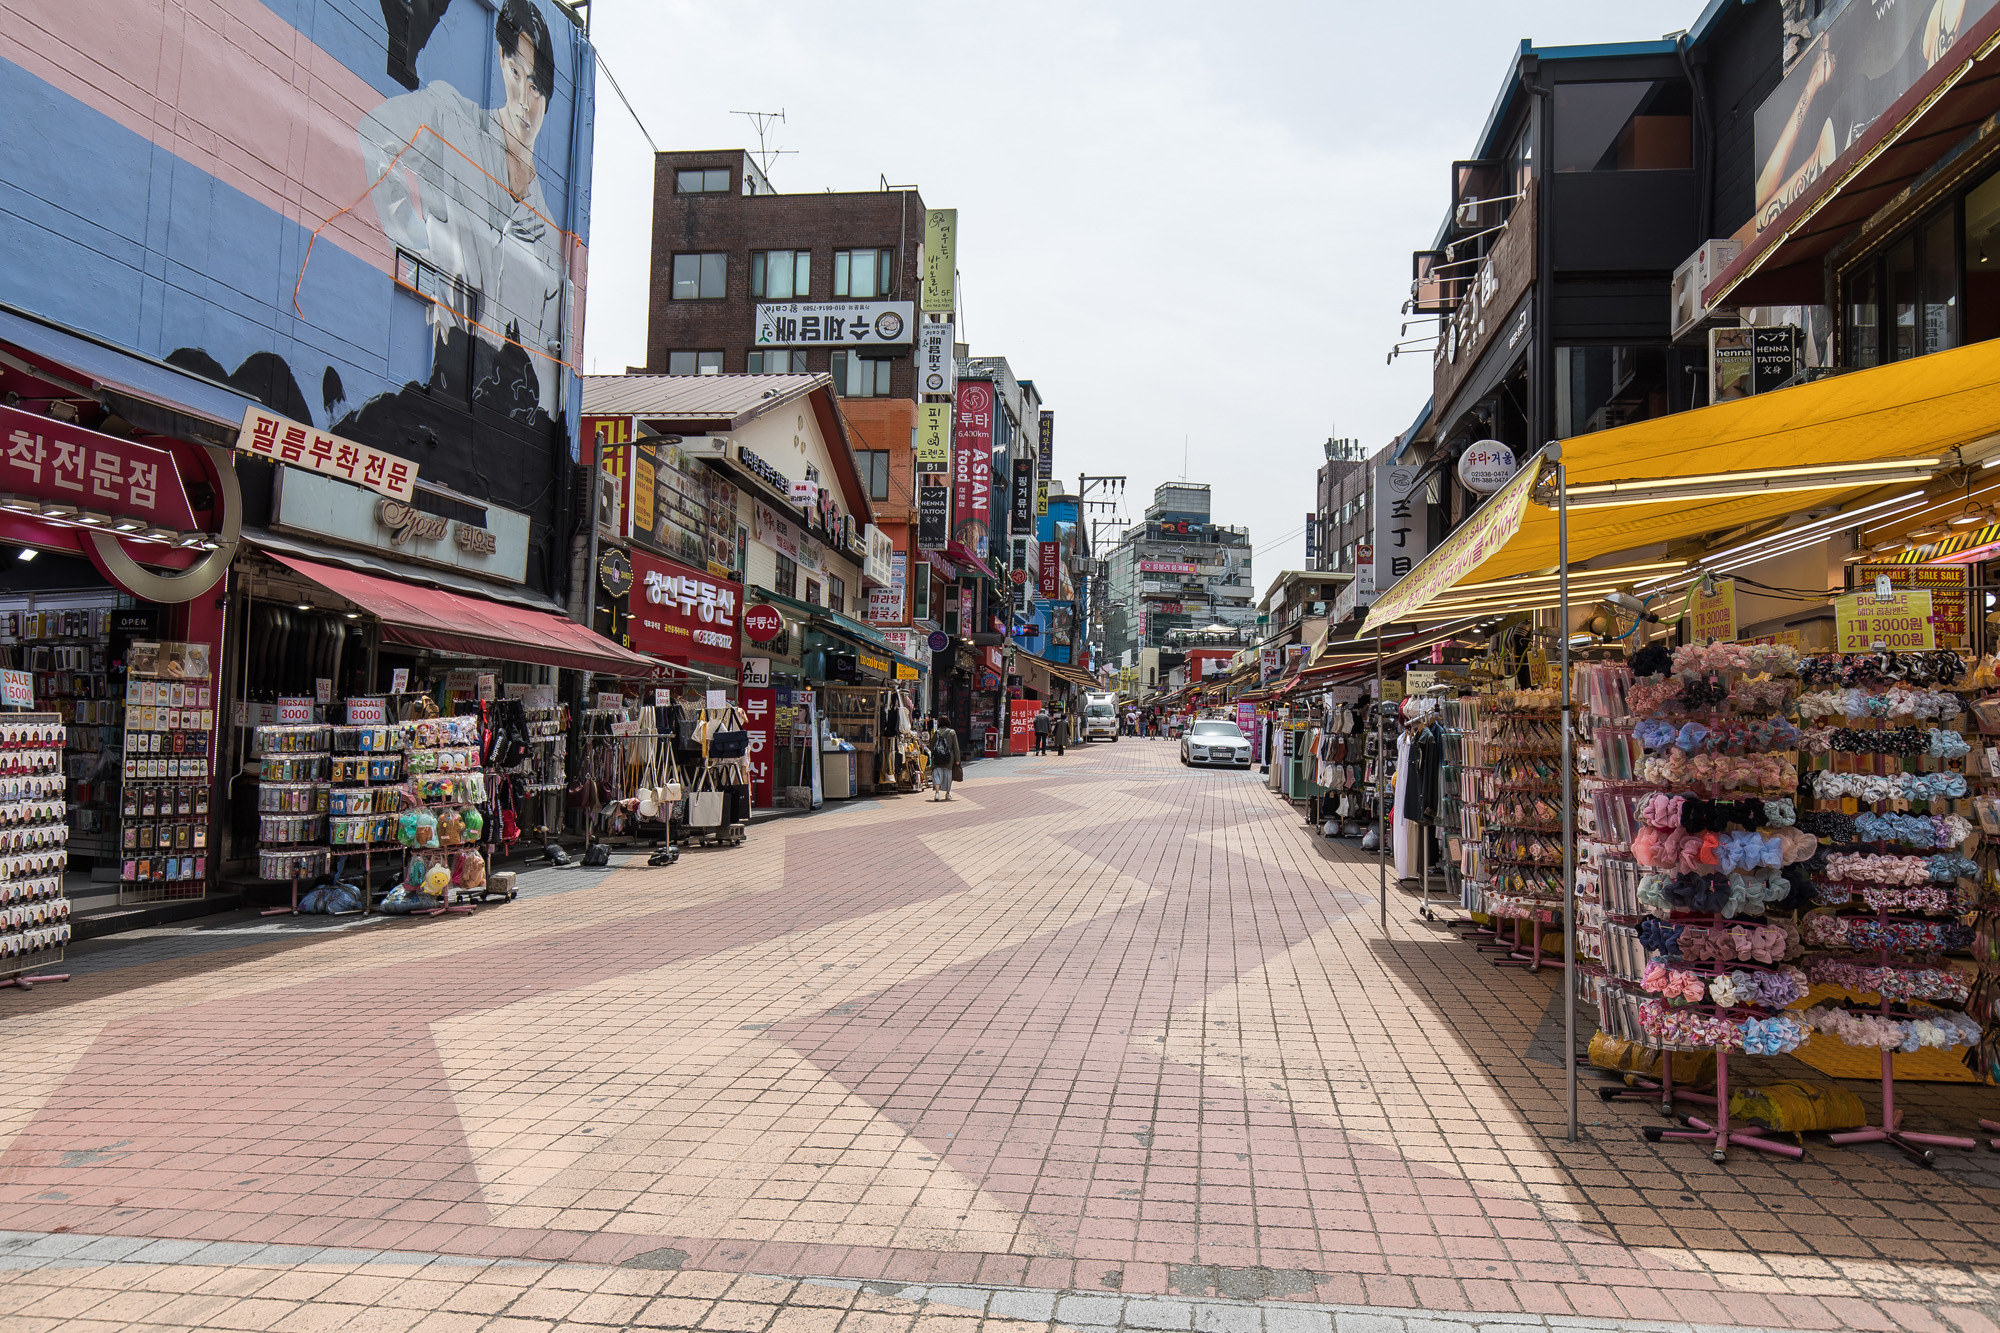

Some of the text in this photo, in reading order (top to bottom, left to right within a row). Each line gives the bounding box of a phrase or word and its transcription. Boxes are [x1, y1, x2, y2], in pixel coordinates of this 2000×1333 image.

[941, 289, 950, 297] 5F
[775, 315, 870, 341] 수제담배
[1758, 332, 1789, 342] ヘンナ
[927, 336, 942, 372] 수제담배
[1716, 349, 1752, 357] henna
[1762, 365, 1782, 375] 文身
[959, 412, 990, 428] 루타
[926, 407, 941, 447] 피규어
[1041, 419, 1051, 454] 더하우스
[919, 448, 947, 459] 프렌즈
[0, 428, 158, 510] 착전문점
[926, 463, 938, 471] B1
[957, 448, 971, 483] food
[971, 448, 989, 510] ASIAN
[922, 490, 946, 498] ヘンナ
[1038, 487, 1048, 512] 사진
[375, 499, 450, 545] Fjord
[1043, 544, 1056, 591] 보드게임
[1886, 571, 1906, 580] SALE
[1918, 571, 1960, 580] SALE SALE
[870, 594, 901, 605] 마라탕
[1857, 595, 1876, 606] BIG
[1161, 603, 1184, 614] DVD
[1857, 606, 1910, 617] 헤어 곱창밴드
[869, 610, 900, 620] 쌀국수
[1695, 607, 1730, 627] 1개 3000원
[121, 618, 147, 626] OPEN
[746, 616, 778, 630] 부동산
[1847, 617, 1923, 633] 1개 3000원
[622, 633, 630, 648] B1
[884, 632, 906, 641] 전문점
[1847, 632, 1924, 648] 2개 5000원
[1531, 664, 1547, 681] 6900
[3, 671, 29, 686] SALE
[480, 676, 491, 685] SALE
[743, 673, 768, 684] PIEU
[3, 686, 32, 701] 15000
[278, 699, 313, 707] BIGSALE
[347, 699, 386, 708] BIGSALE
[281, 709, 309, 719] 3000
[351, 710, 381, 720] 8000
[1011, 718, 1027, 726] SALE
[747, 699, 768, 784] 부동산
